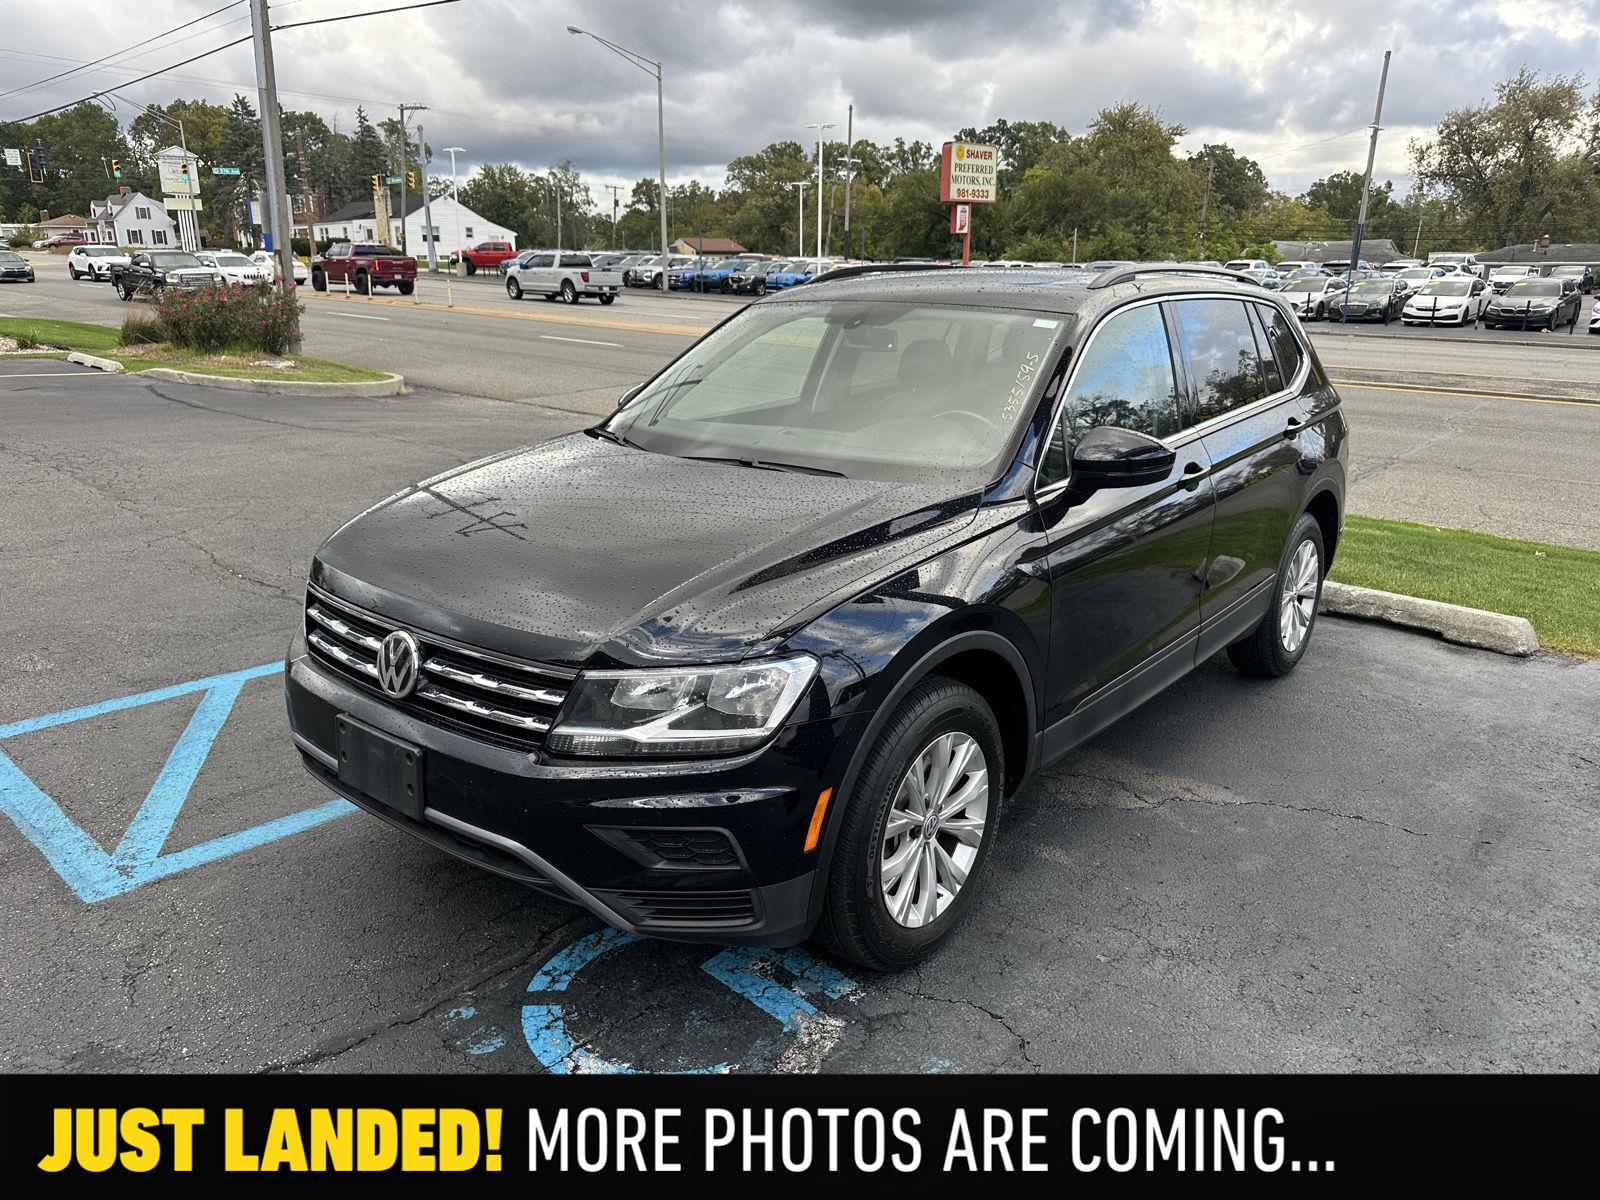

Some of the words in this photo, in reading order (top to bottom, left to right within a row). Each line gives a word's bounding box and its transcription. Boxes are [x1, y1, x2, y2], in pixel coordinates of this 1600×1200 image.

[966, 149, 992, 160] SHAVER
[954, 163, 993, 174] PREFERRED
[951, 175, 981, 186] MOTORS,
[982, 176, 995, 187] INC.
[956, 188, 989, 199] 981-9333
